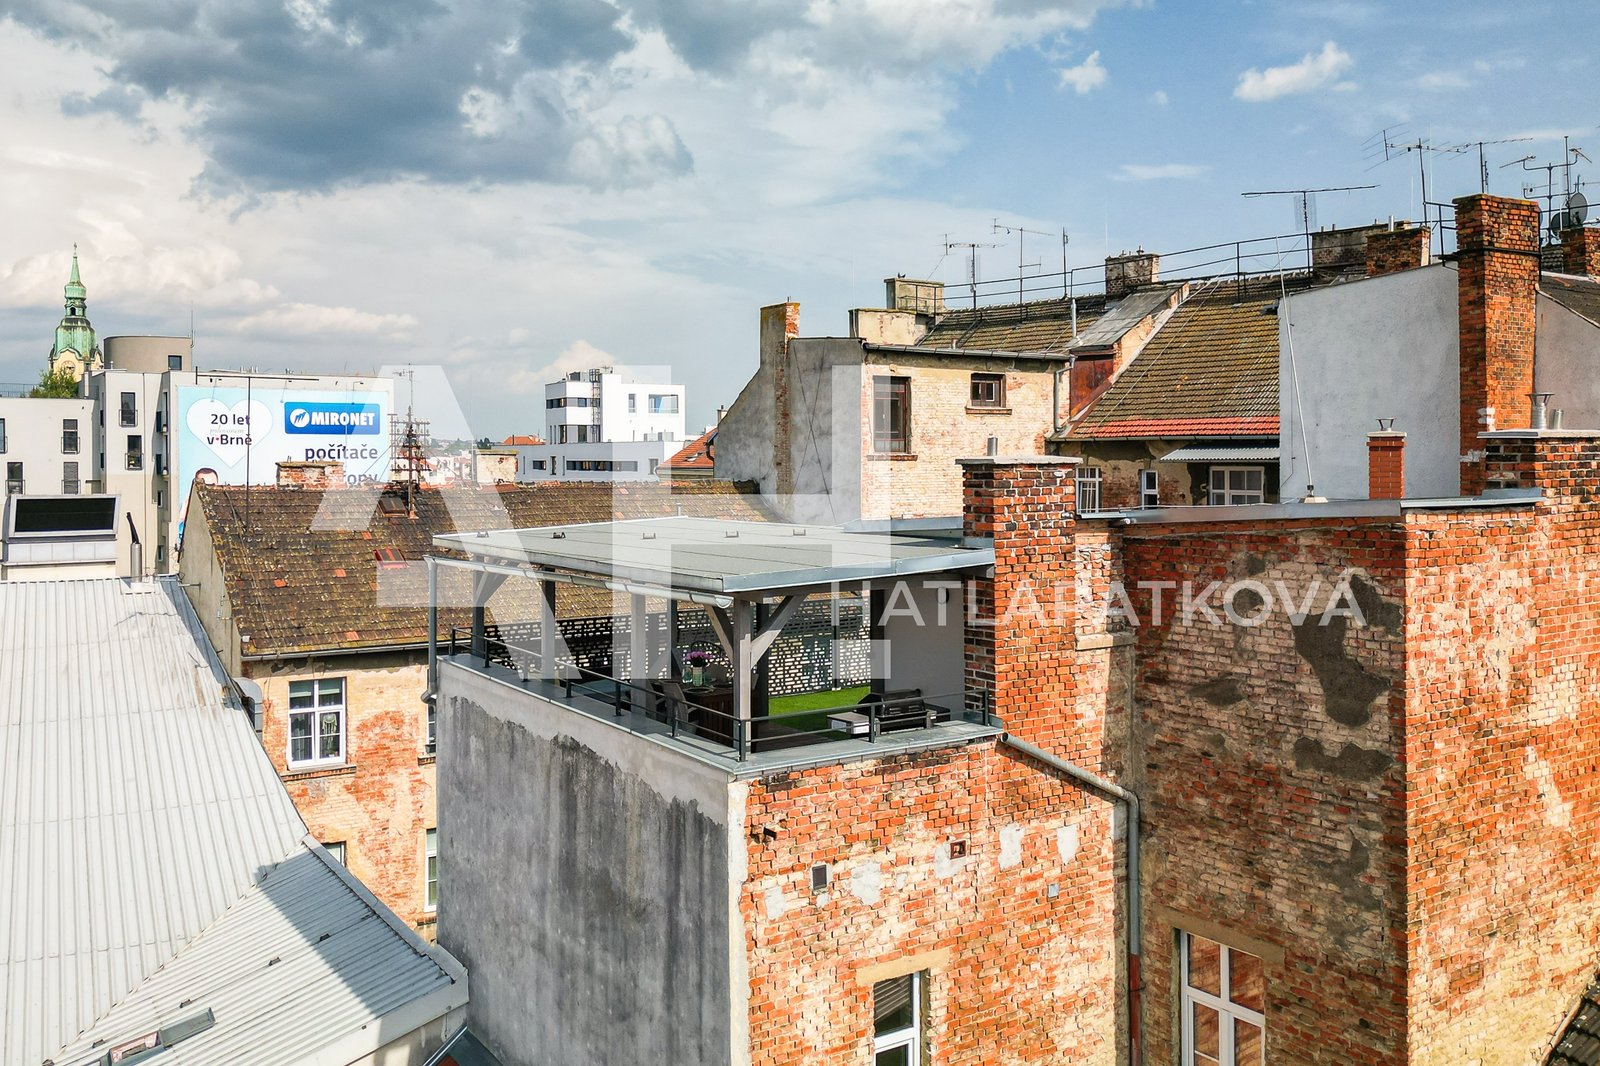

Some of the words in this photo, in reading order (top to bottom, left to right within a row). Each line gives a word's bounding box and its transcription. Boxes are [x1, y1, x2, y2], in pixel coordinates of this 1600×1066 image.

[211, 414, 228, 425] 20
[233, 414, 250, 425] let
[311, 412, 375, 426] MIRONET
[220, 433, 252, 445] Brně
[305, 443, 378, 461] počítače
